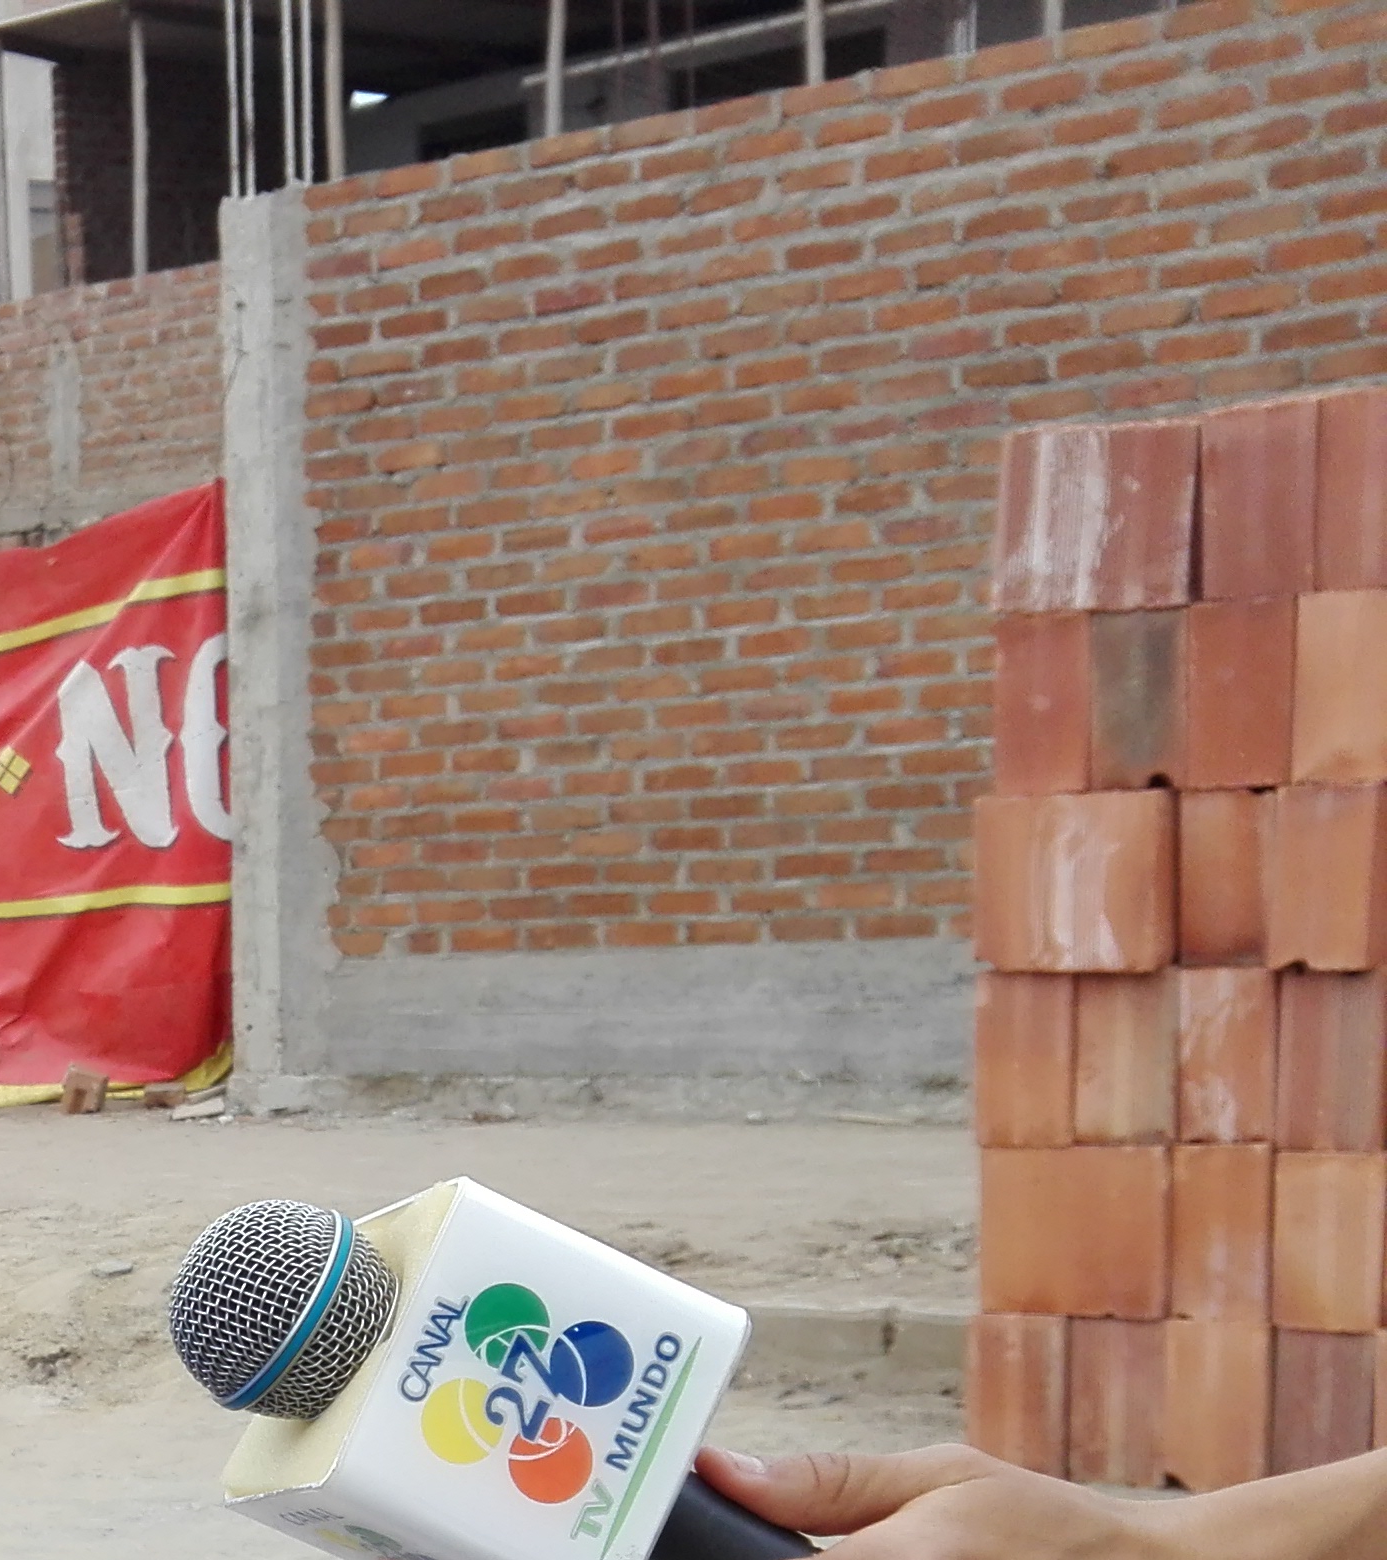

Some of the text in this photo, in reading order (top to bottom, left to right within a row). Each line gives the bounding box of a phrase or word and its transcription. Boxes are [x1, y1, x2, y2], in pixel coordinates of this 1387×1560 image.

[399, 1297, 472, 1402] CANAL
[485, 1330, 563, 1442] 27
[570, 1331, 684, 1540] TV MUNDO
